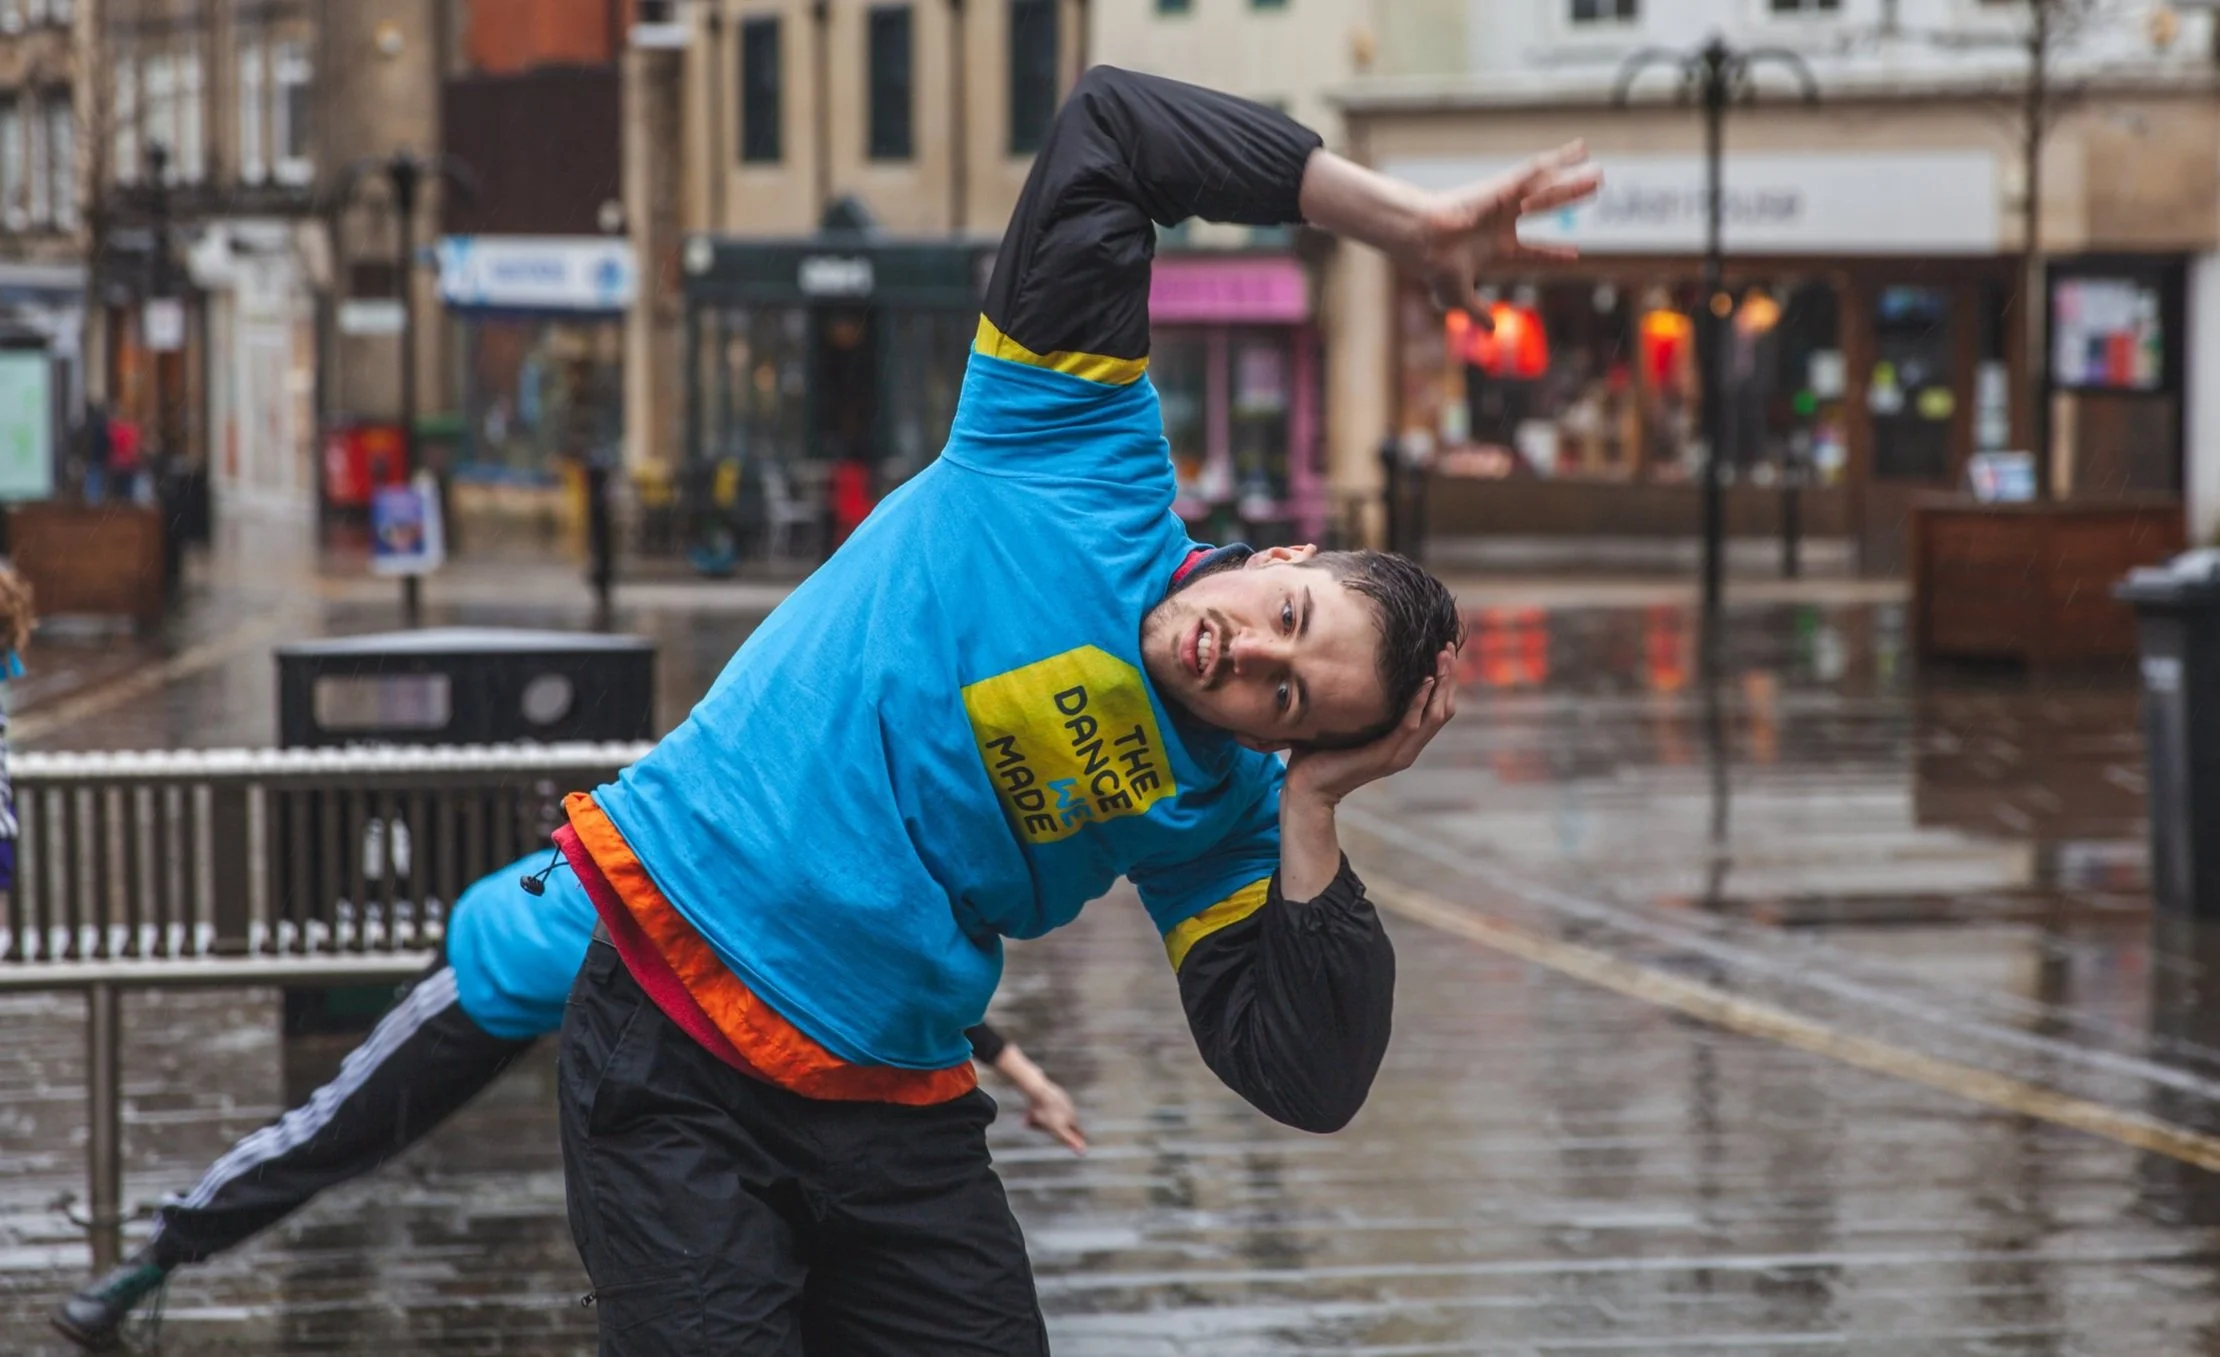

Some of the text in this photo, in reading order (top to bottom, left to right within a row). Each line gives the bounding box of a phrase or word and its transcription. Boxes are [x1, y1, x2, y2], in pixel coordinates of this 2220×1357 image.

[987, 736, 1057, 833] MADE
[1055, 686, 1133, 813] DANCE
[1115, 725, 1160, 799] THE
[1048, 779, 1091, 828] WE
